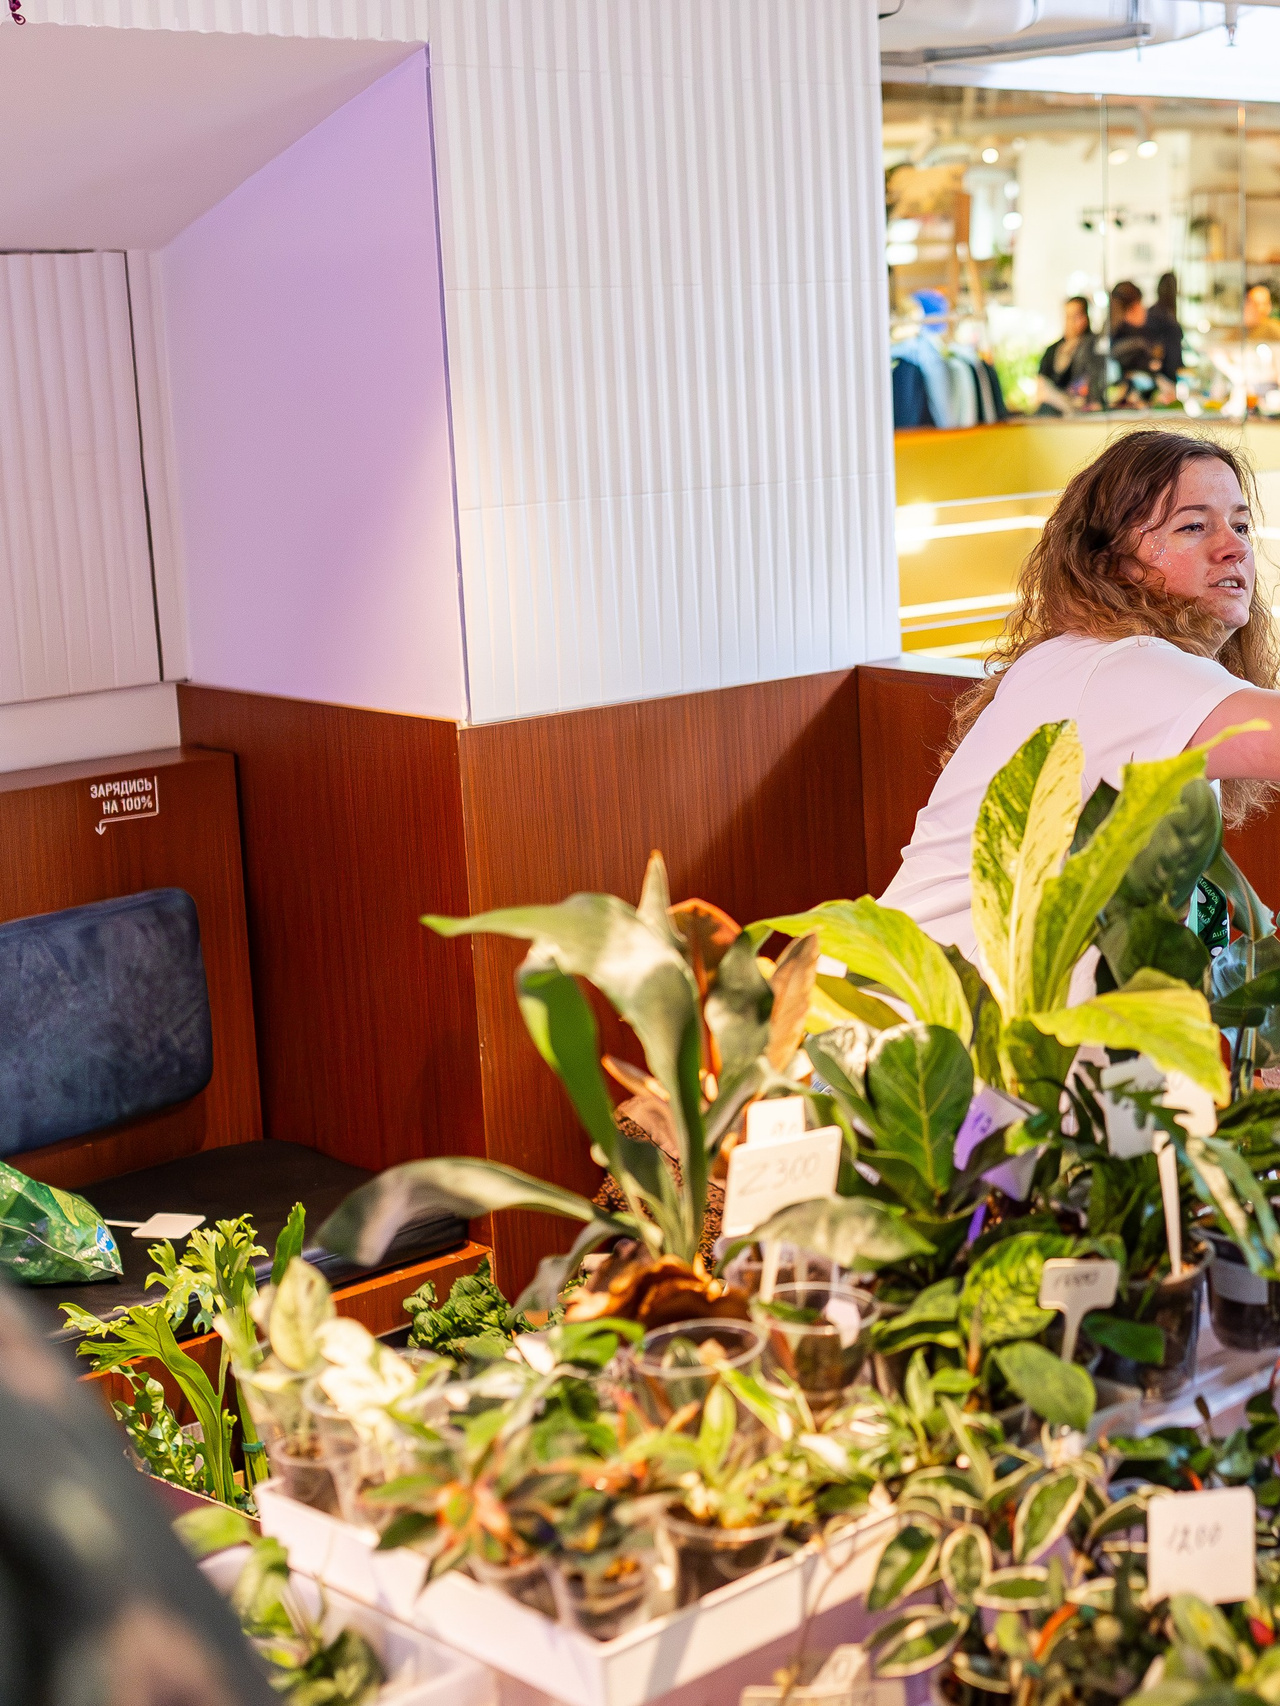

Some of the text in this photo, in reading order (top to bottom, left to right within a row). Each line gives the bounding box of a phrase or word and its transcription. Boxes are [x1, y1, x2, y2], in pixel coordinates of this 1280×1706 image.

[90, 777, 152, 798] ЗАРЯДИСЬ
[102, 794, 153, 815] НА 100%
[737, 1151, 821, 1198] 2300
